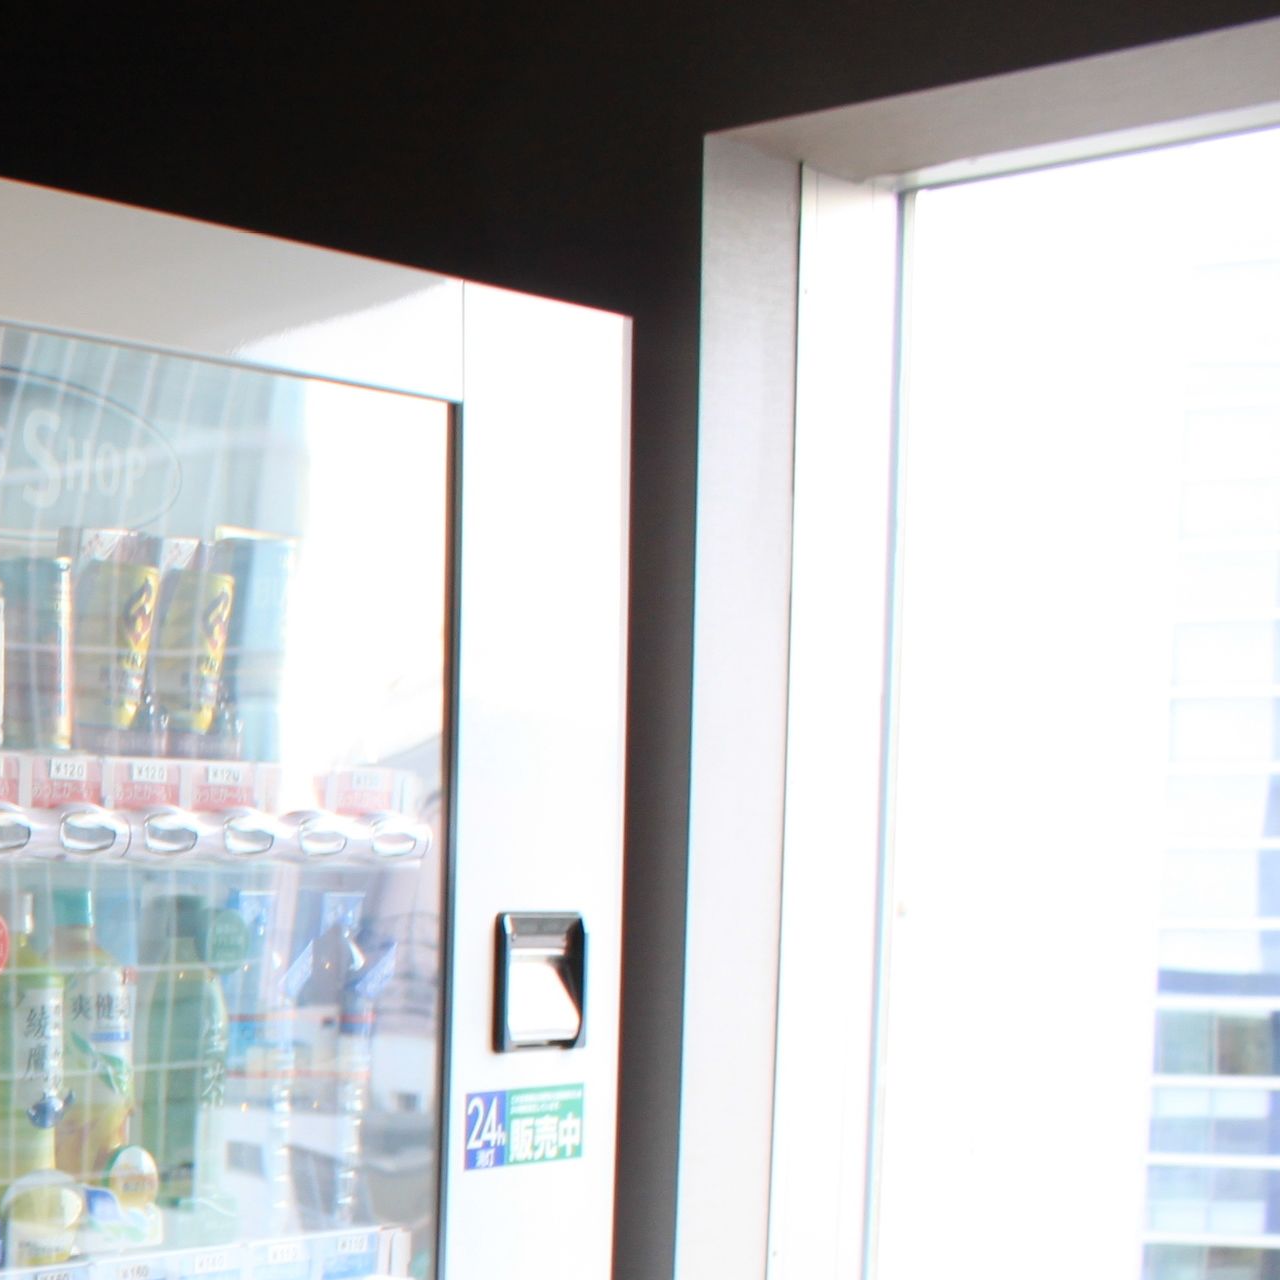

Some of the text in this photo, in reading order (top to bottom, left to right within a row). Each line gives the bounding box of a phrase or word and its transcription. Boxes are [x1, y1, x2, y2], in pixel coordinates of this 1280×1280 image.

[52, 764, 85, 778] ¥120
[466, 1095, 506, 1151] 24h
[509, 1111, 582, 1163] 販売中
